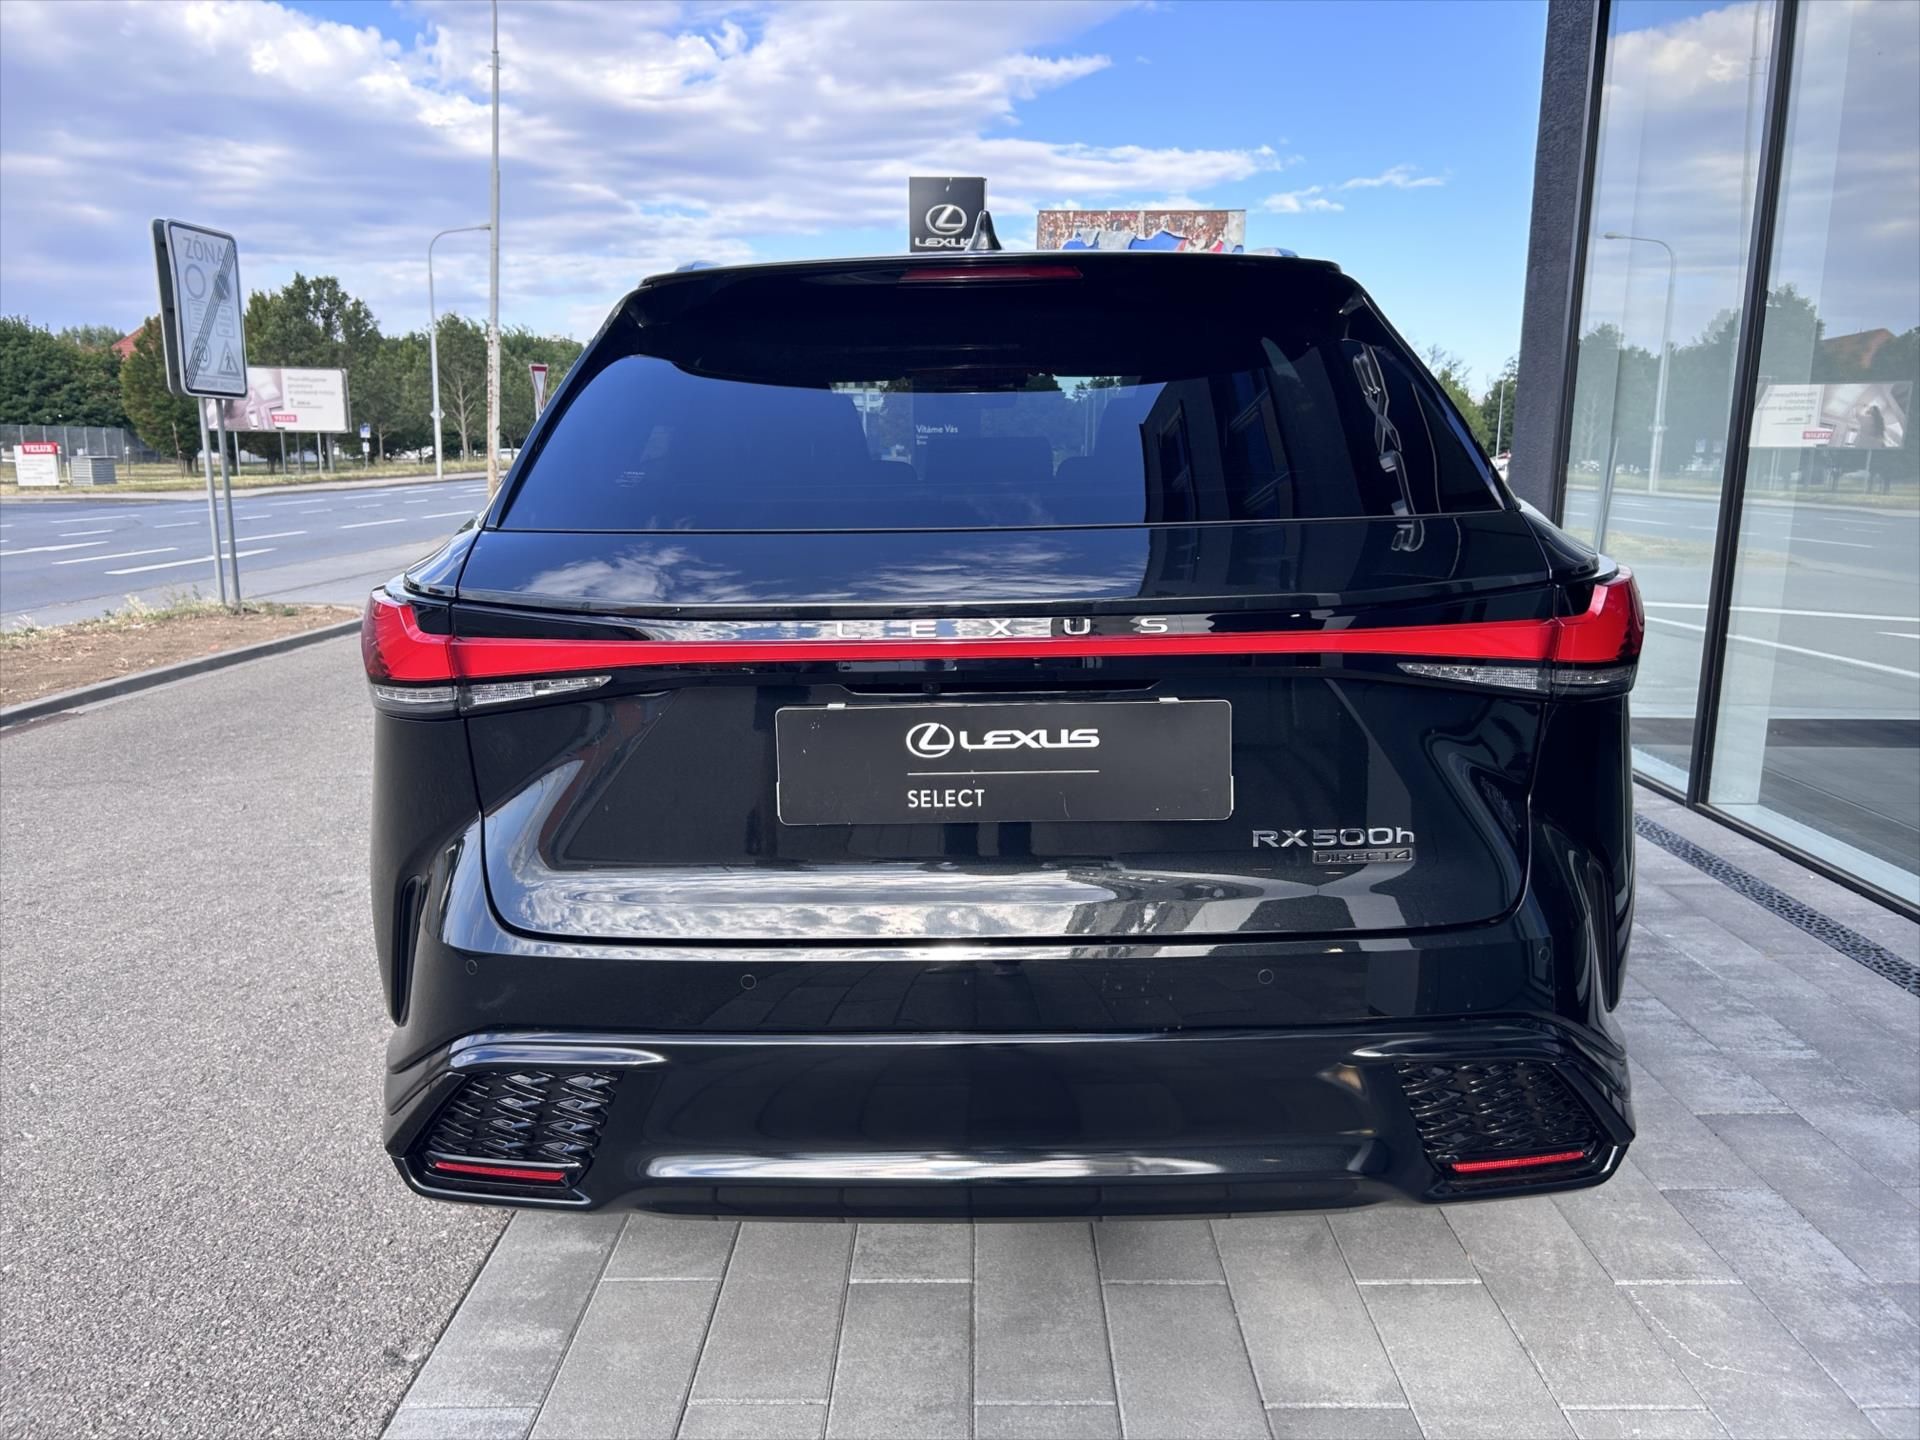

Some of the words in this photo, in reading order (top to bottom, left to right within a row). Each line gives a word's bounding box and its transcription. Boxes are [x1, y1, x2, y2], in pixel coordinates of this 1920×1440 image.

[183, 235, 226, 265] ZÓNA
[836, 617, 1169, 639] LEXUS
[959, 728, 1100, 750] LEXUS
[907, 789, 985, 808] SELECT
